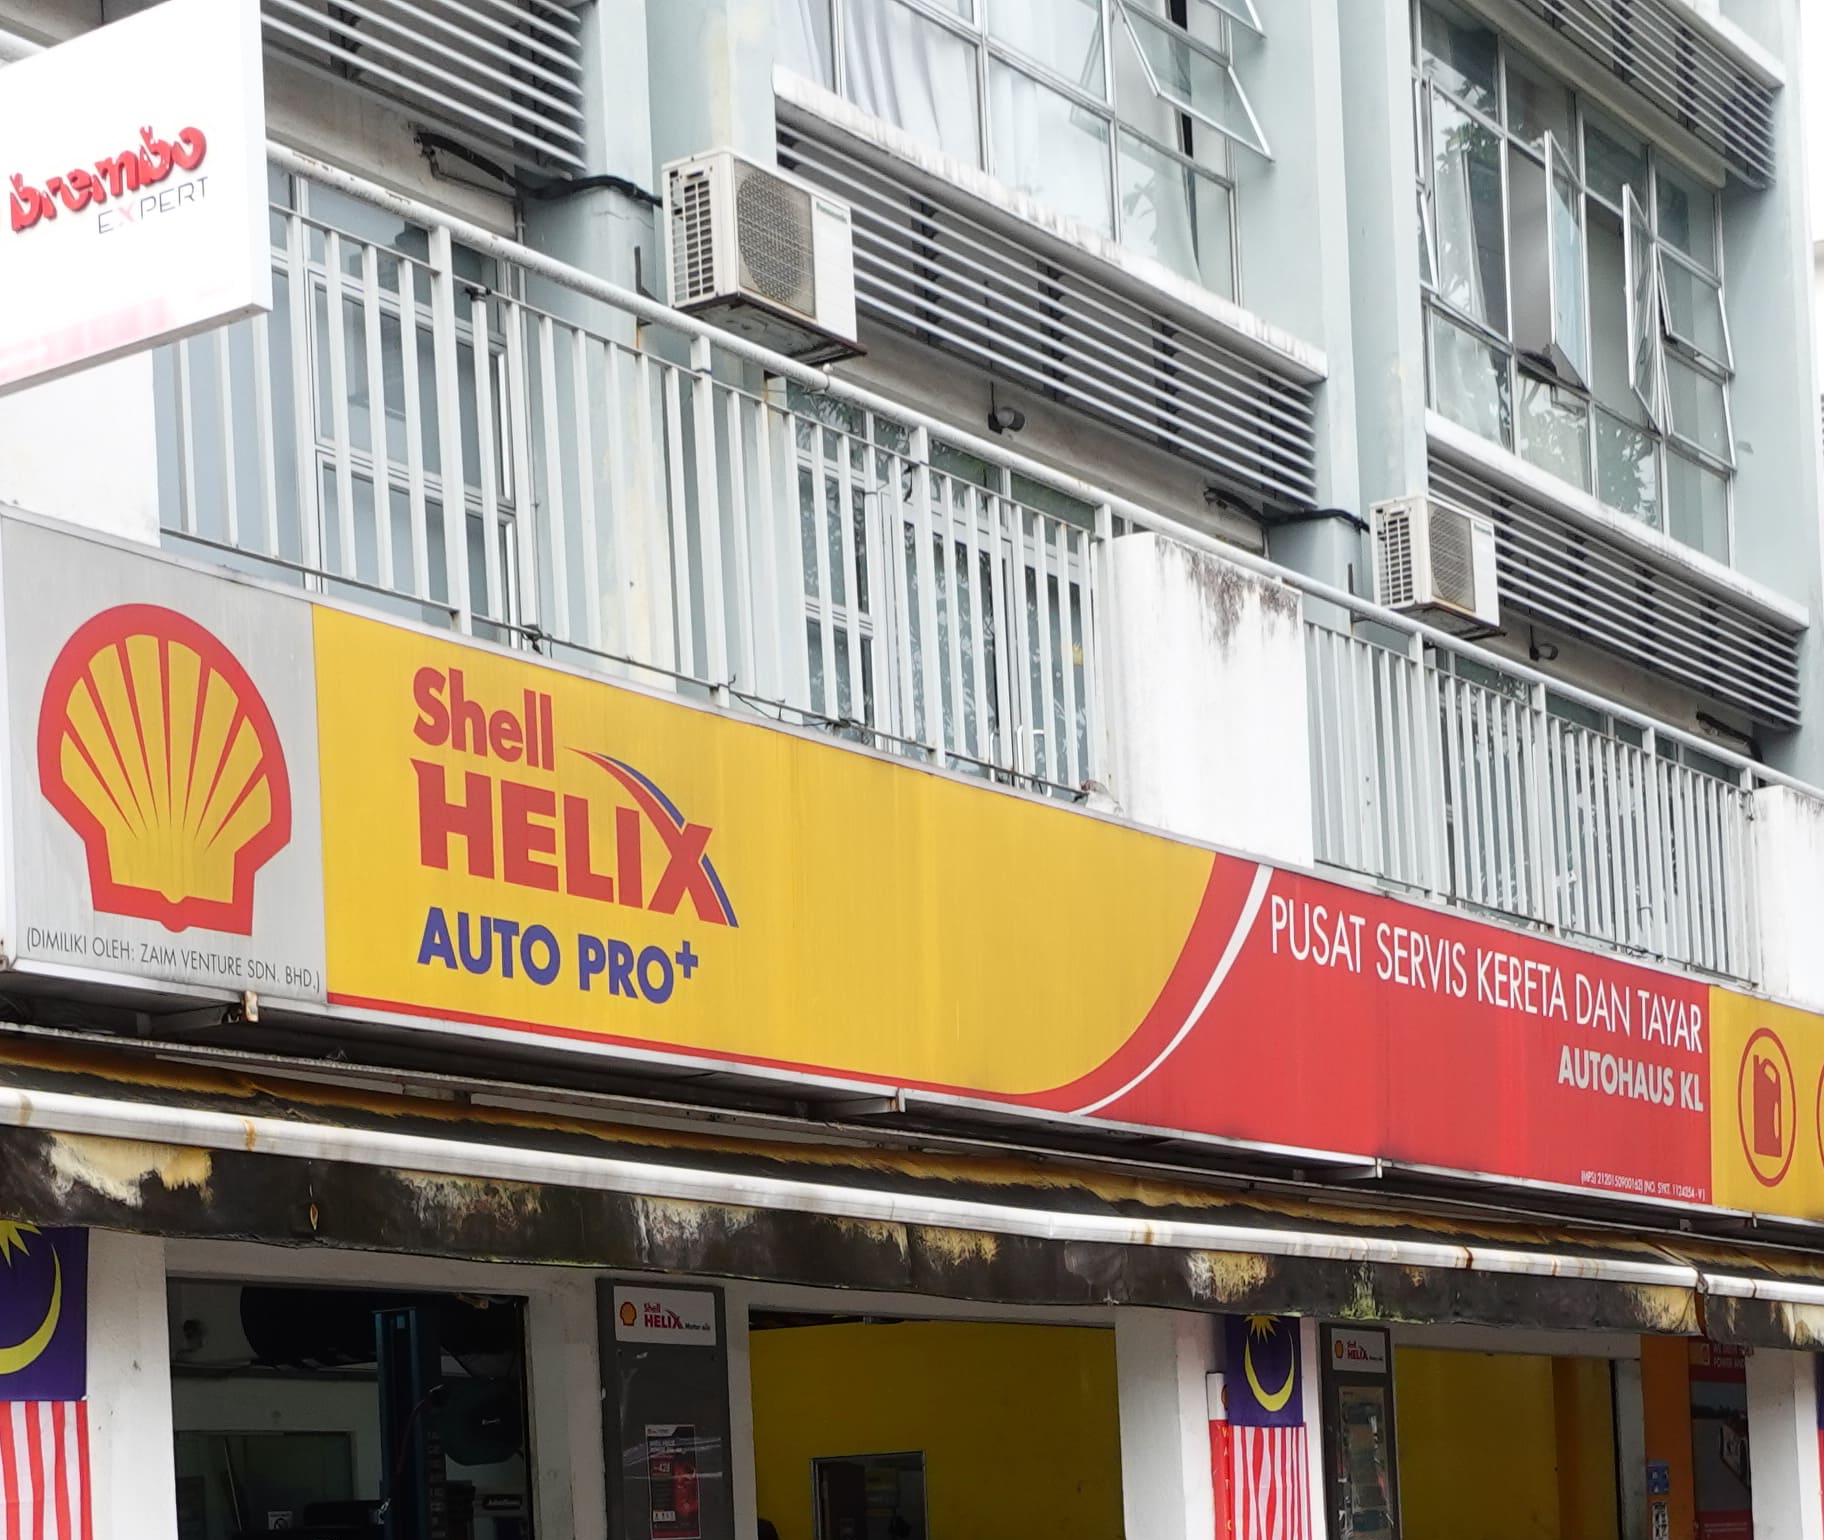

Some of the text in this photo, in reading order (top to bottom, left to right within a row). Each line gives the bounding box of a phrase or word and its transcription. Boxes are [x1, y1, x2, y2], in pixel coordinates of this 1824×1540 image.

[10, 125, 207, 233] brembo
[98, 177, 208, 234] EXPERT
[413, 666, 555, 772] Shell
[410, 747, 738, 928] HELIX
[26, 926, 321, 994] (DIMILIKI OLEH: ZAIM VENTURE SDN. BHD.)
[417, 906, 562, 988] AUTO
[1270, 893, 1703, 1053] PUSAT SERVIS KERETA DAN TAYAR
[1558, 1045, 1704, 1113] AUTOHAUS KL
[644, 1309, 684, 1329] HELIX
